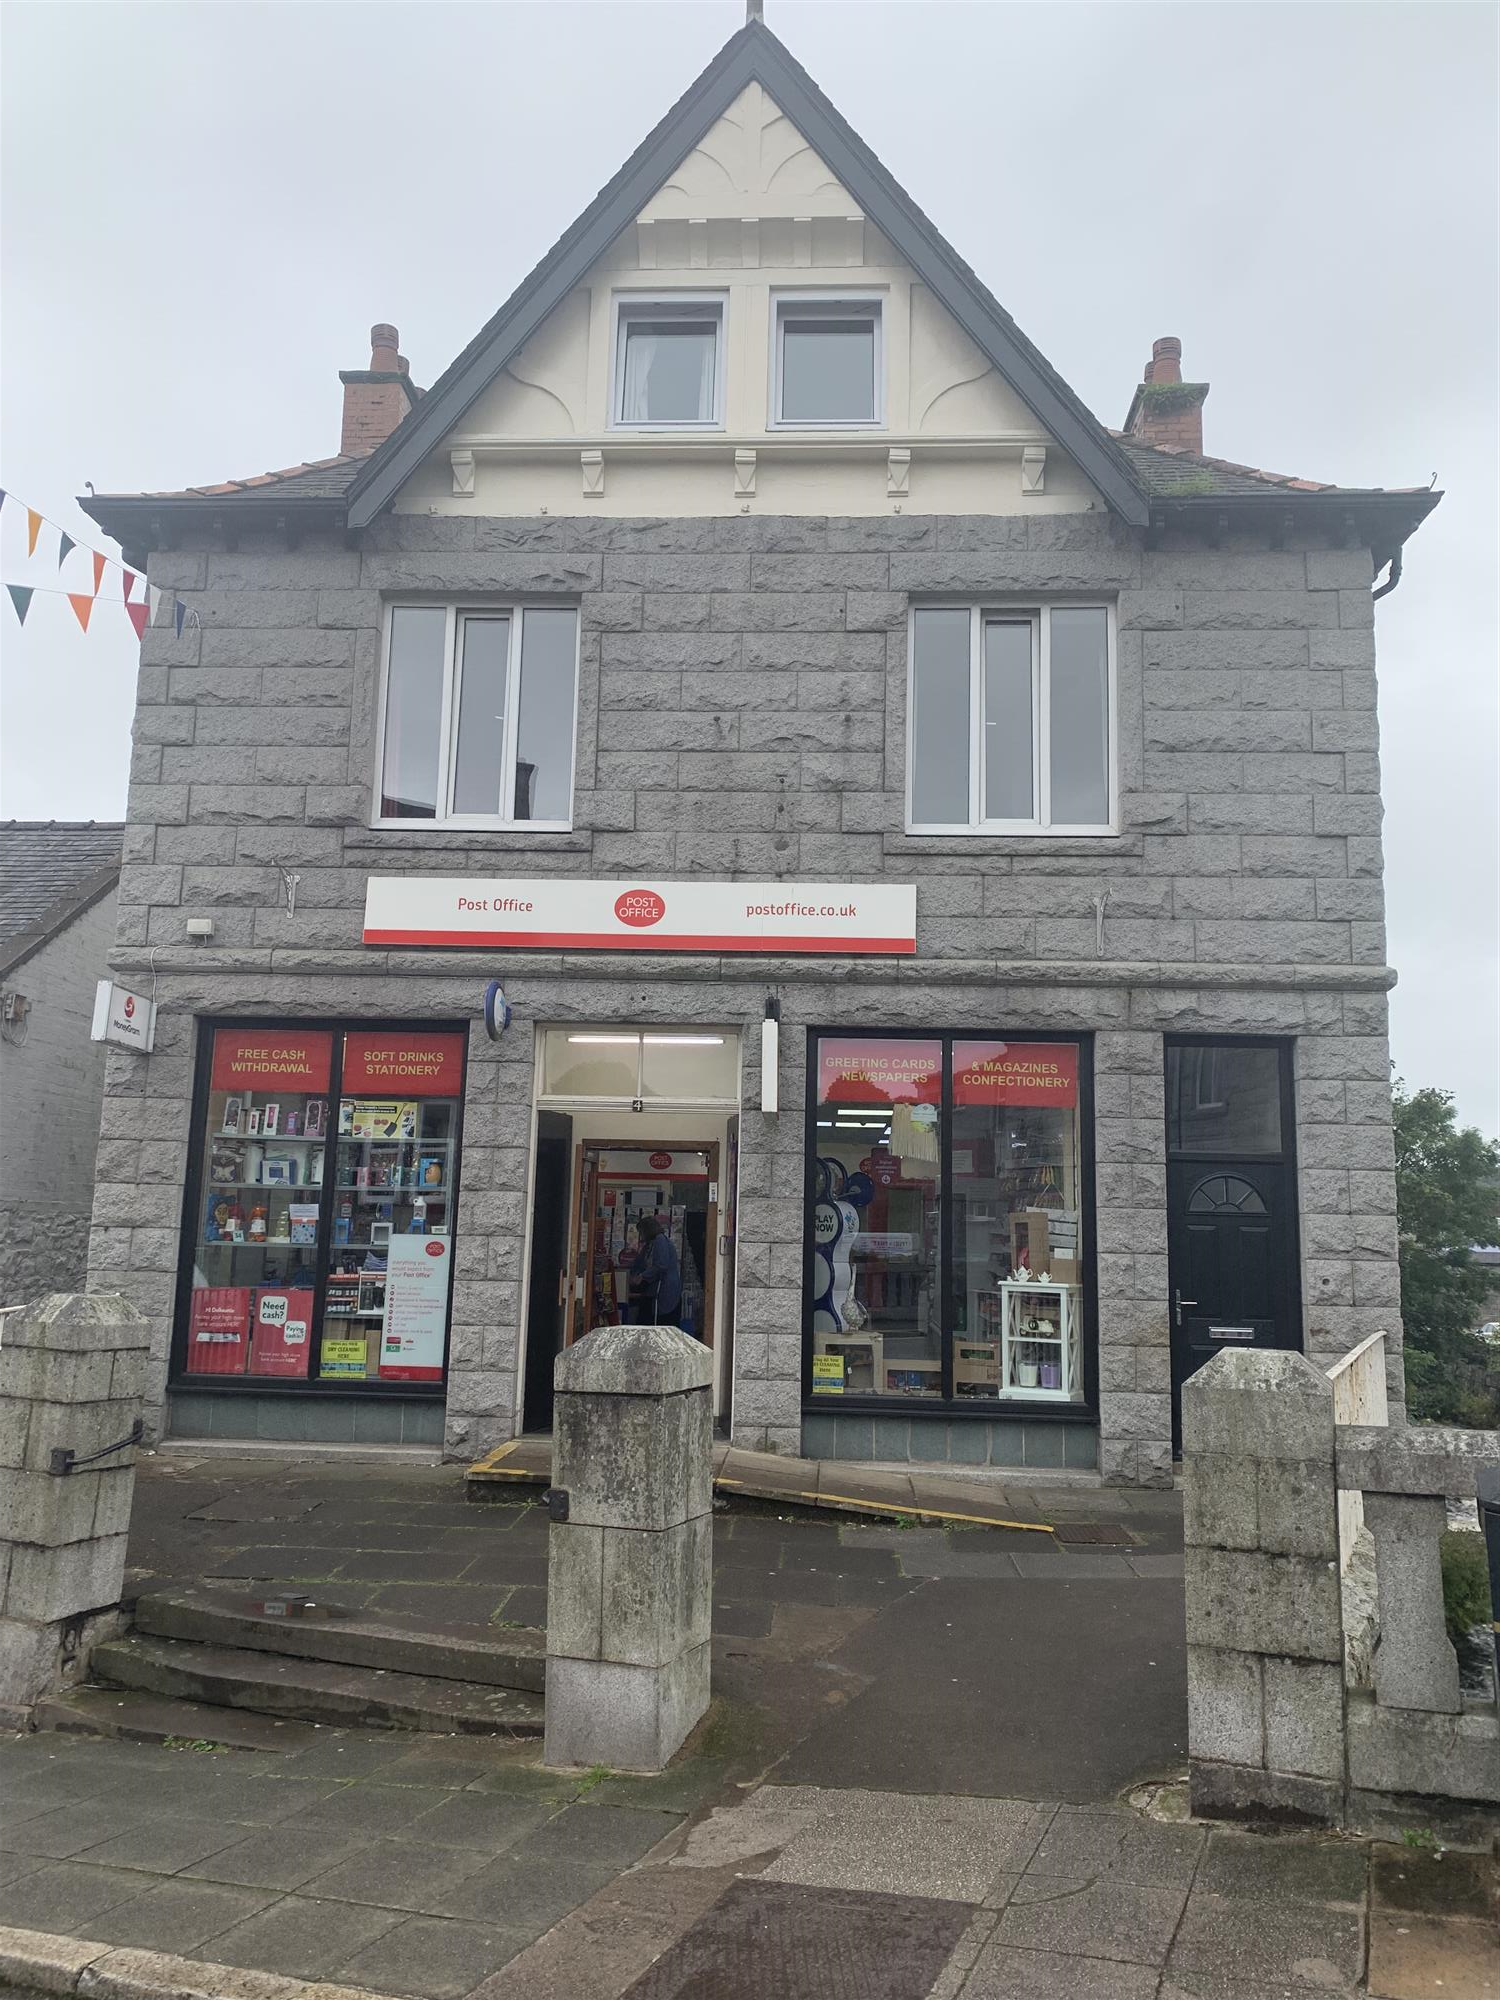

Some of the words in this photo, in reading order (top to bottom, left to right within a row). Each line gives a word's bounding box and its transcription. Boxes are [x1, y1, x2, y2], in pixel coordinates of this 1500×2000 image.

[458, 897, 488, 911] Post
[493, 898, 534, 912] Office
[626, 897, 656, 907] POST
[618, 908, 659, 918] OFFICE
[746, 903, 857, 918] postoffice.co.uk
[113, 1020, 140, 1036] MoneyGram
[237, 1048, 269, 1059] FREE
[272, 1049, 306, 1060] CASH
[364, 1051, 396, 1061] SOFT
[399, 1052, 444, 1062] DRINKS
[230, 1062, 313, 1074] WITHDRAWAL
[826, 1056, 888, 1068] GREETING
[892, 1058, 936, 1070] CARDS
[971, 1061, 980, 1071] &
[983, 1062, 1058, 1074] MAGAZINES
[366, 1064, 440, 1075] STATIONERY
[842, 1071, 928, 1083] NEWSPAPERS
[962, 1074, 1070, 1088] CONFECTIONERY
[633, 1101, 642, 1111] 4
[262, 1301, 286, 1310] Need
[262, 1311, 285, 1319] cash?
